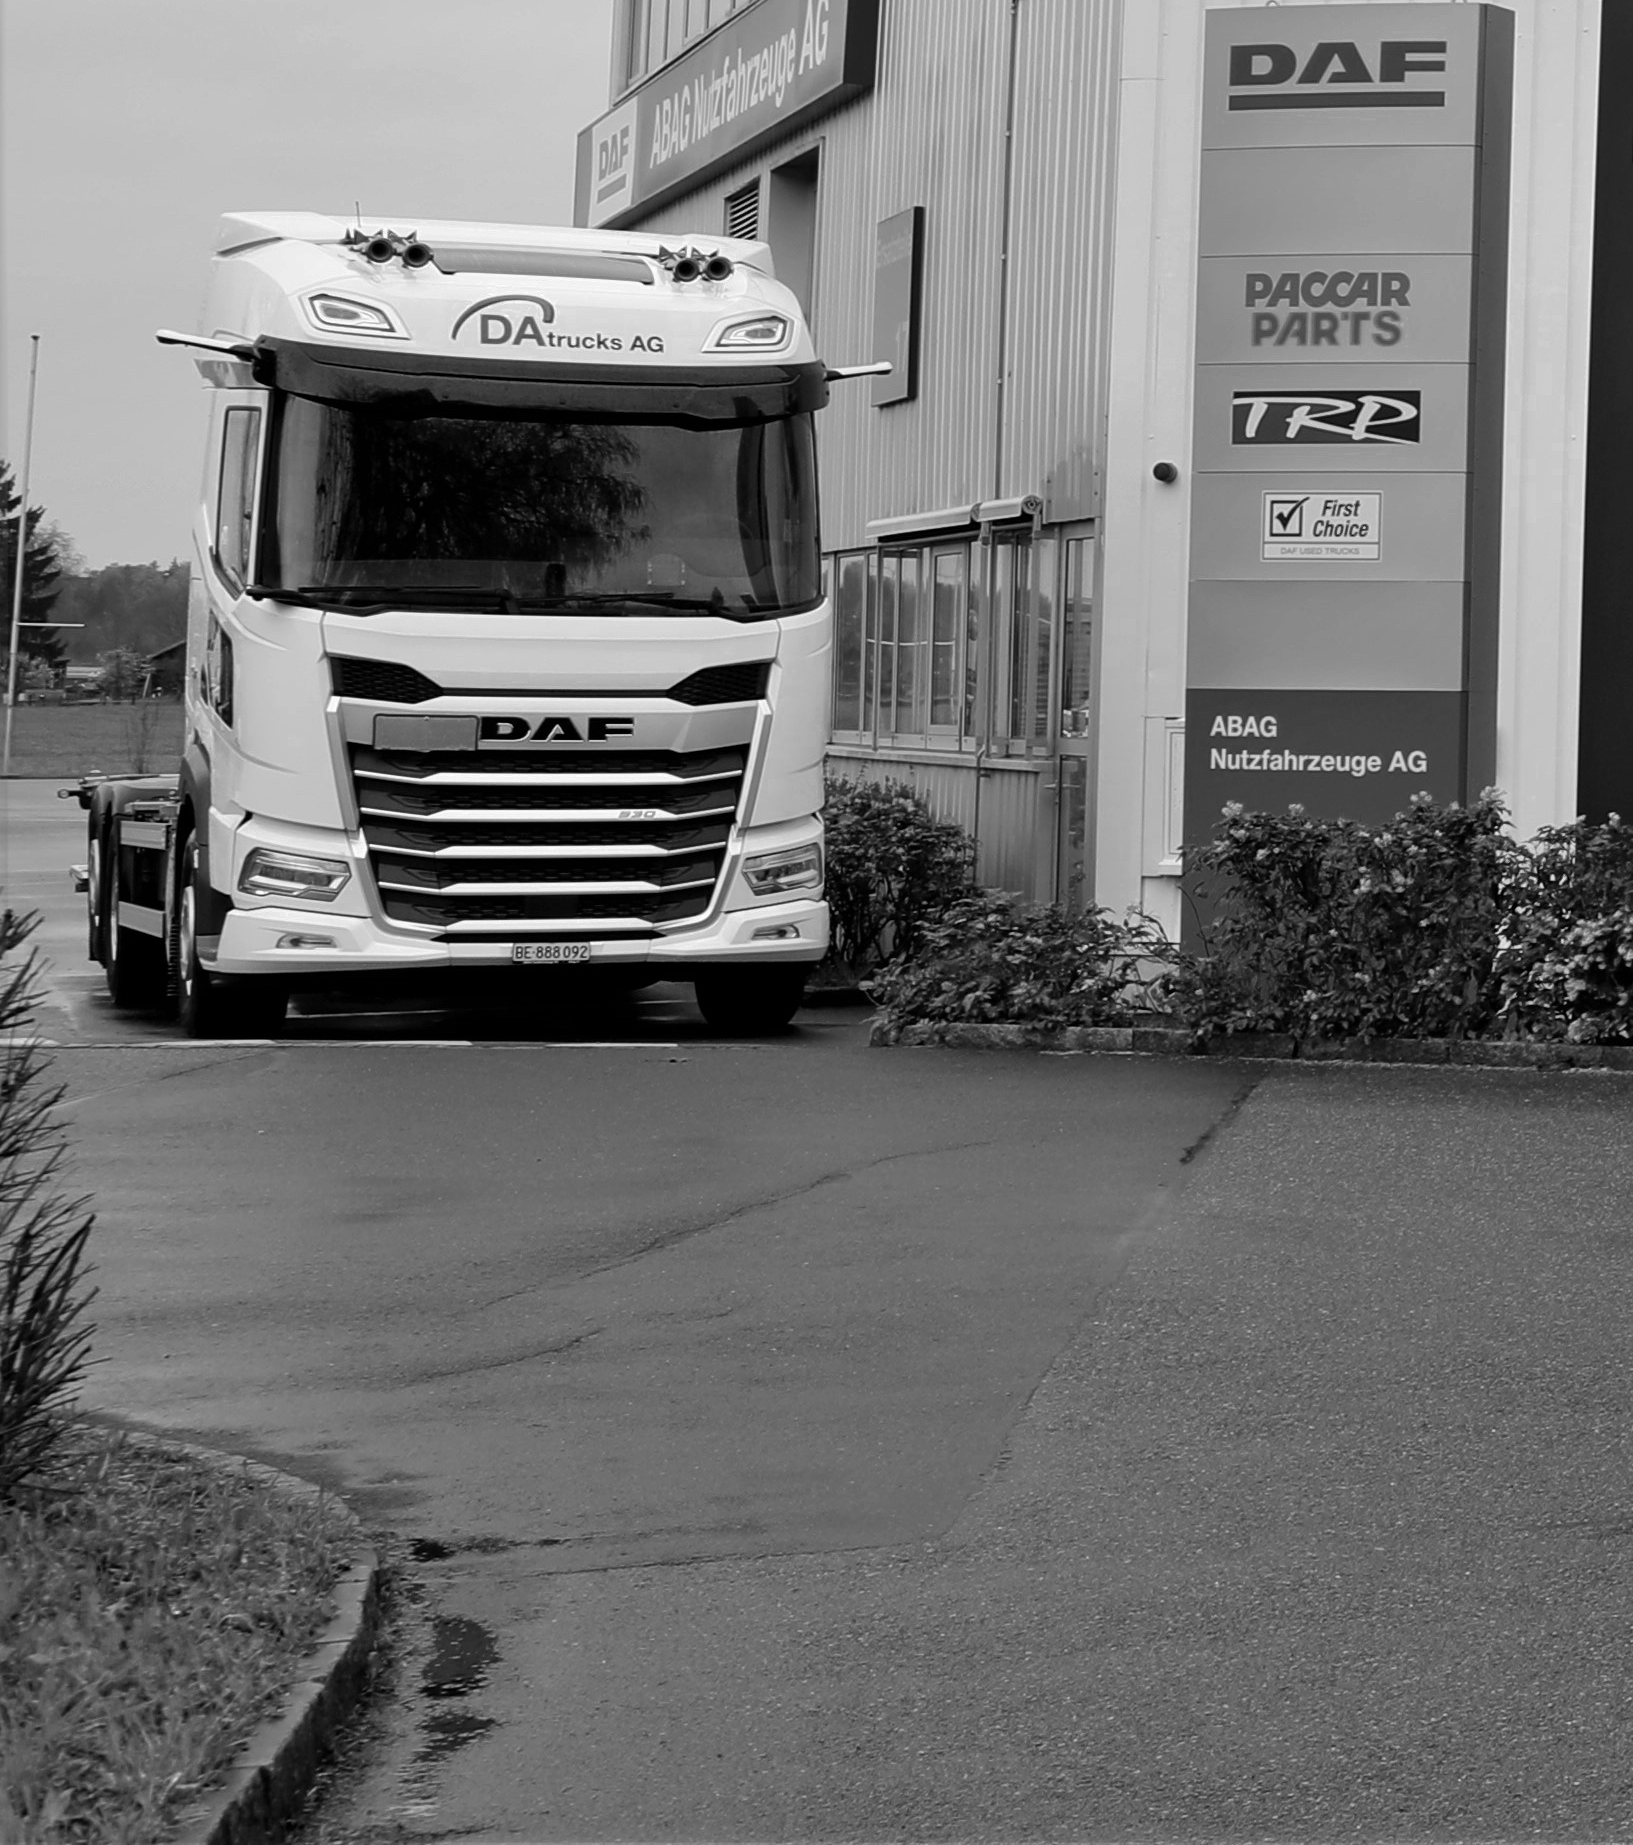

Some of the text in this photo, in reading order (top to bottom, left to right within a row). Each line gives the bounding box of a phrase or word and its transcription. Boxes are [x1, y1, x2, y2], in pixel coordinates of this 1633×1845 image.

[1229, 40, 1448, 87] DAF
[650, 84, 691, 170] ABAG
[691, 27, 797, 145] Nutzfahrzeuge
[598, 123, 632, 182] DAF
[1244, 270, 1412, 308] PACCAR
[629, 335, 665, 353] AG
[1251, 310, 1403, 348] PARTS
[1231, 395, 1420, 445] TRP
[1320, 499, 1361, 518] First
[1311, 519, 1369, 539] Choice
[479, 716, 635, 743] DAF
[1210, 715, 1278, 738] ABAG
[1209, 748, 1428, 777] Nutzfahrzeuge AG
